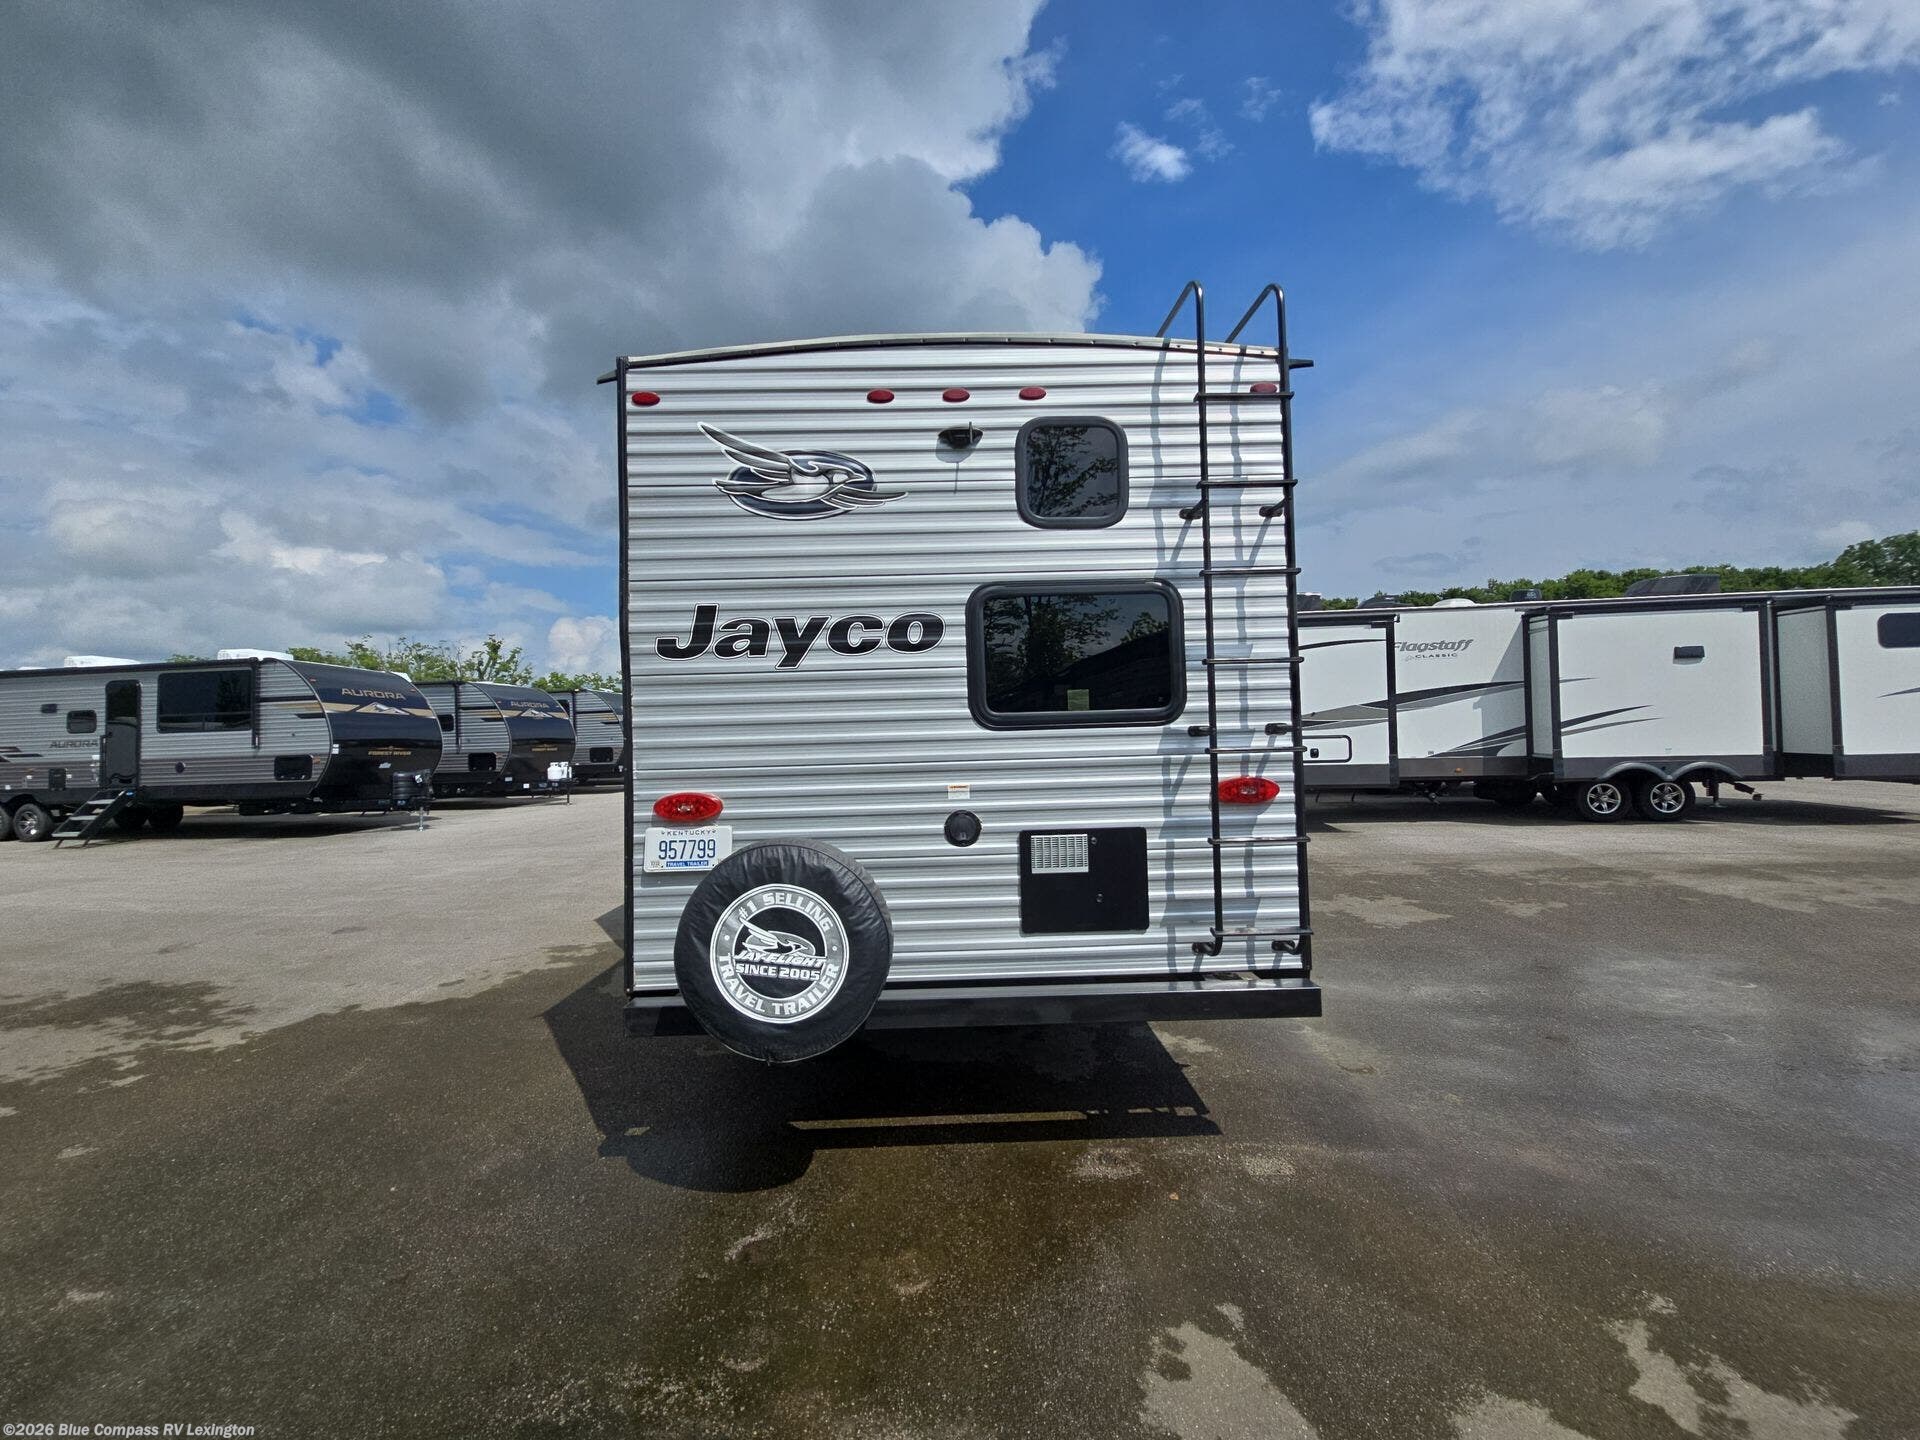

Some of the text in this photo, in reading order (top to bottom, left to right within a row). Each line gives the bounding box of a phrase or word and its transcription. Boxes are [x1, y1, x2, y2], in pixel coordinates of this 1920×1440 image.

[655, 602, 945, 670] Jayco
[341, 688, 406, 700] AURORA
[511, 700, 550, 709] AURORA
[49, 740, 99, 748] AURORA
[658, 839, 716, 860] 957799
[738, 892, 834, 931] #1 SELLING
[735, 963, 820, 981] SINCE 2005
[719, 953, 840, 1015] TRAVEL TRAILER
